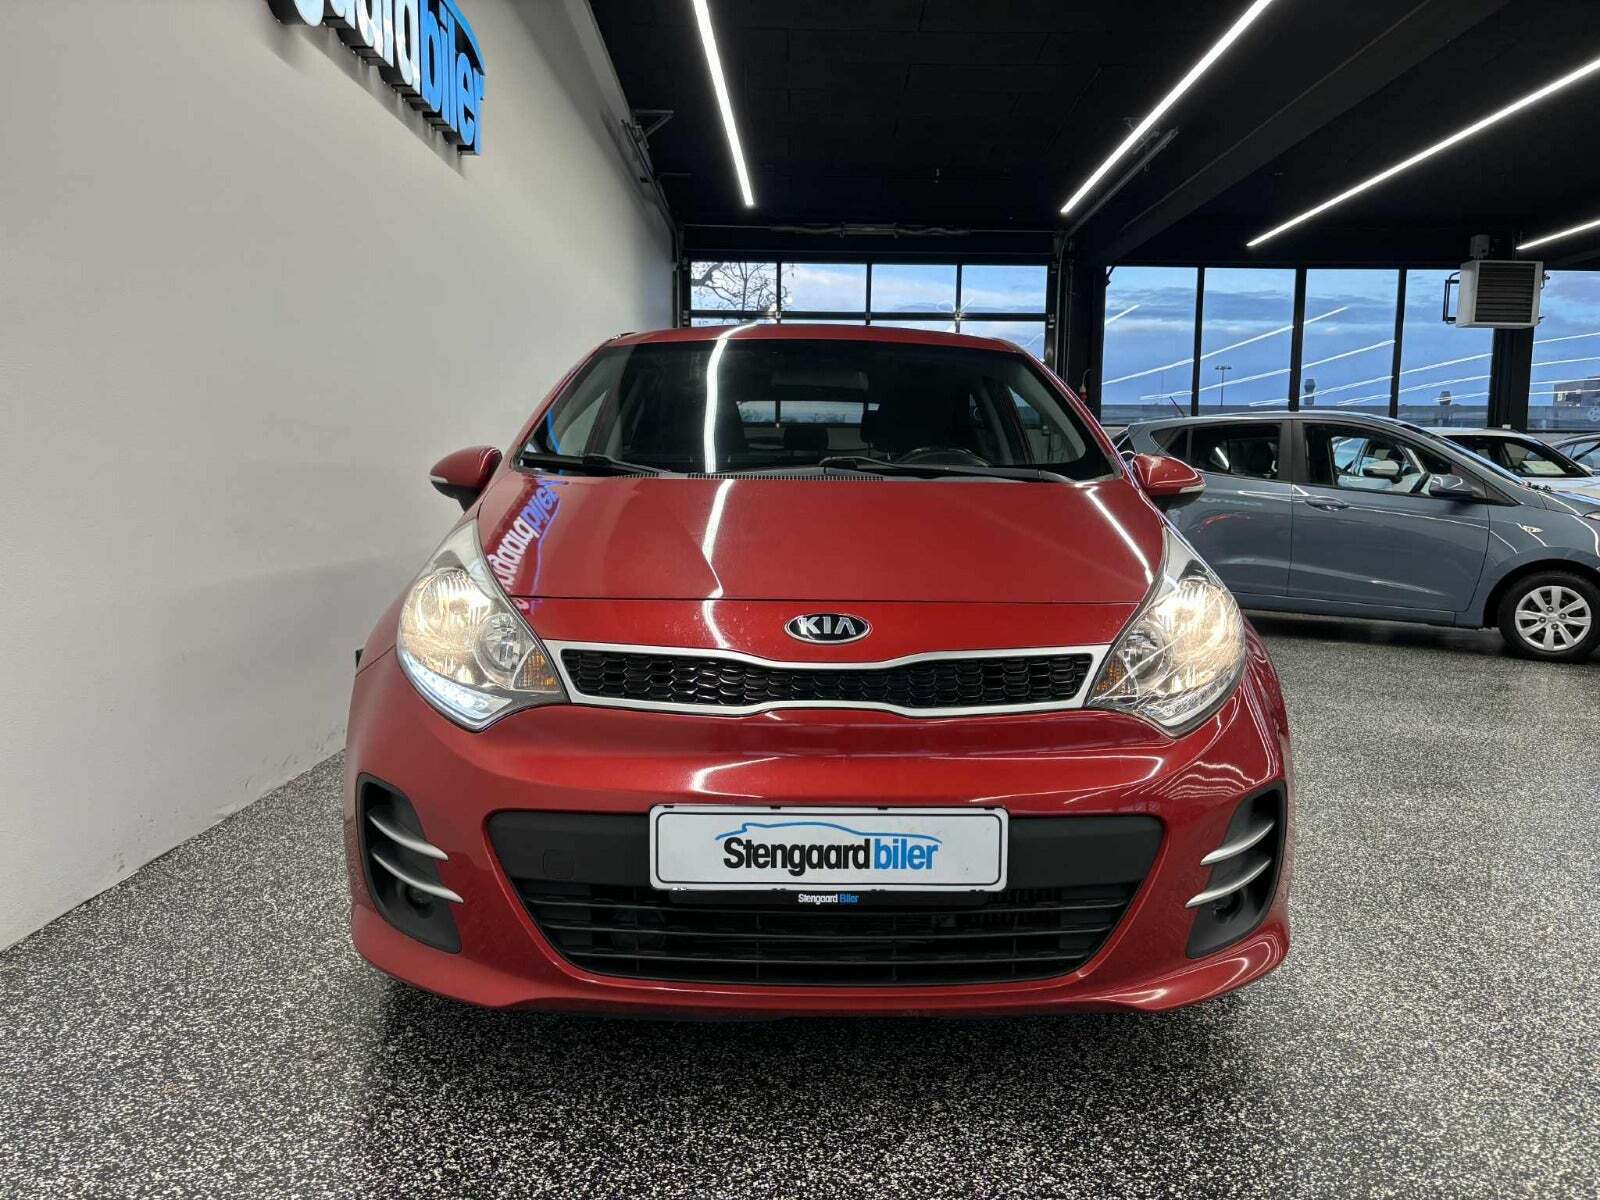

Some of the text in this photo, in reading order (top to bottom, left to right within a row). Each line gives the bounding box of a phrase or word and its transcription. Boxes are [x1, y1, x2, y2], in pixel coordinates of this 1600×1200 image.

[798, 616, 856, 635] KIA
[798, 893, 860, 905] Stengaard Biler
